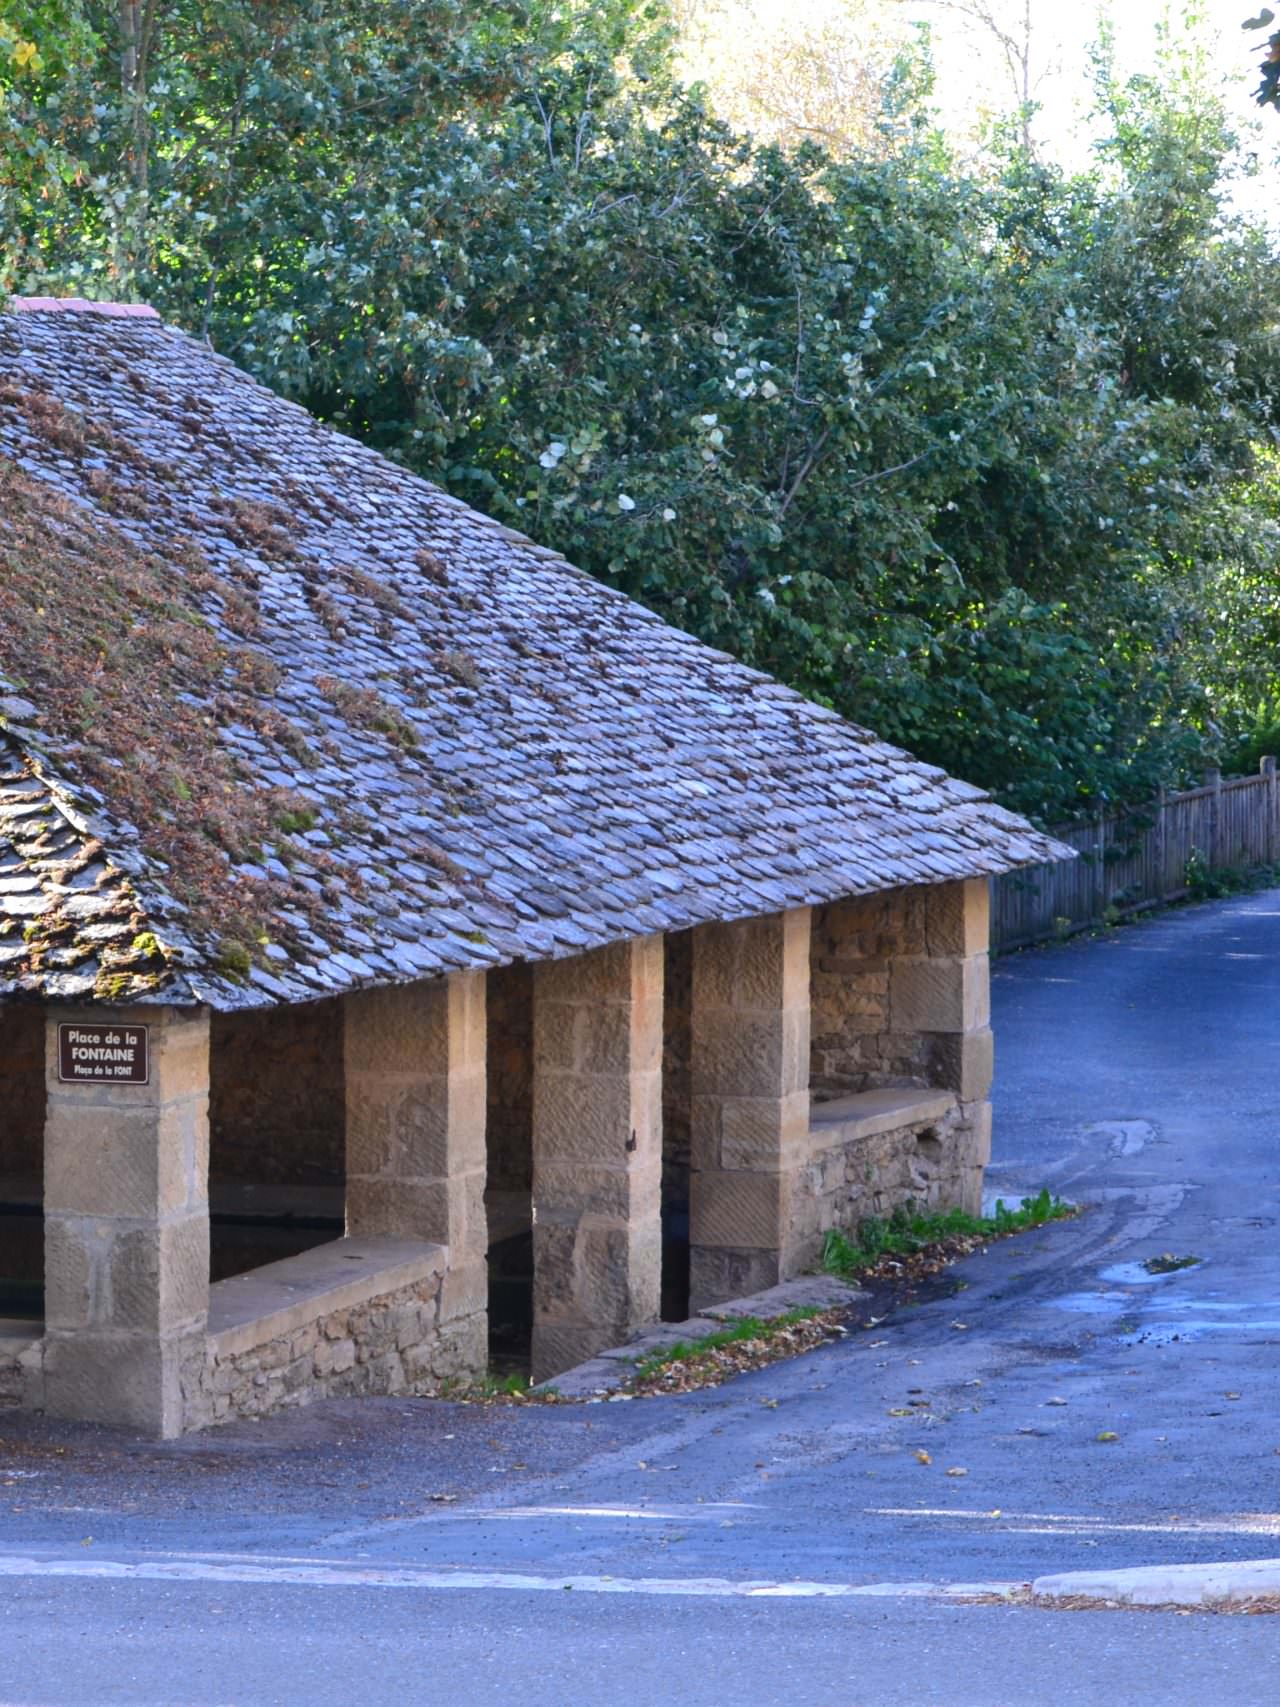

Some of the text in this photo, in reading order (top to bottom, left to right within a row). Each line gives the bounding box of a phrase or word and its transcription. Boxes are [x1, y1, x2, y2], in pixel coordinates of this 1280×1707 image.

[69, 1031, 137, 1045] Place de la
[72, 1048, 134, 1061] FONTAINE
[94, 1065, 103, 1075] de
[105, 1065, 113, 1075] la
[114, 1066, 132, 1076] FONT
